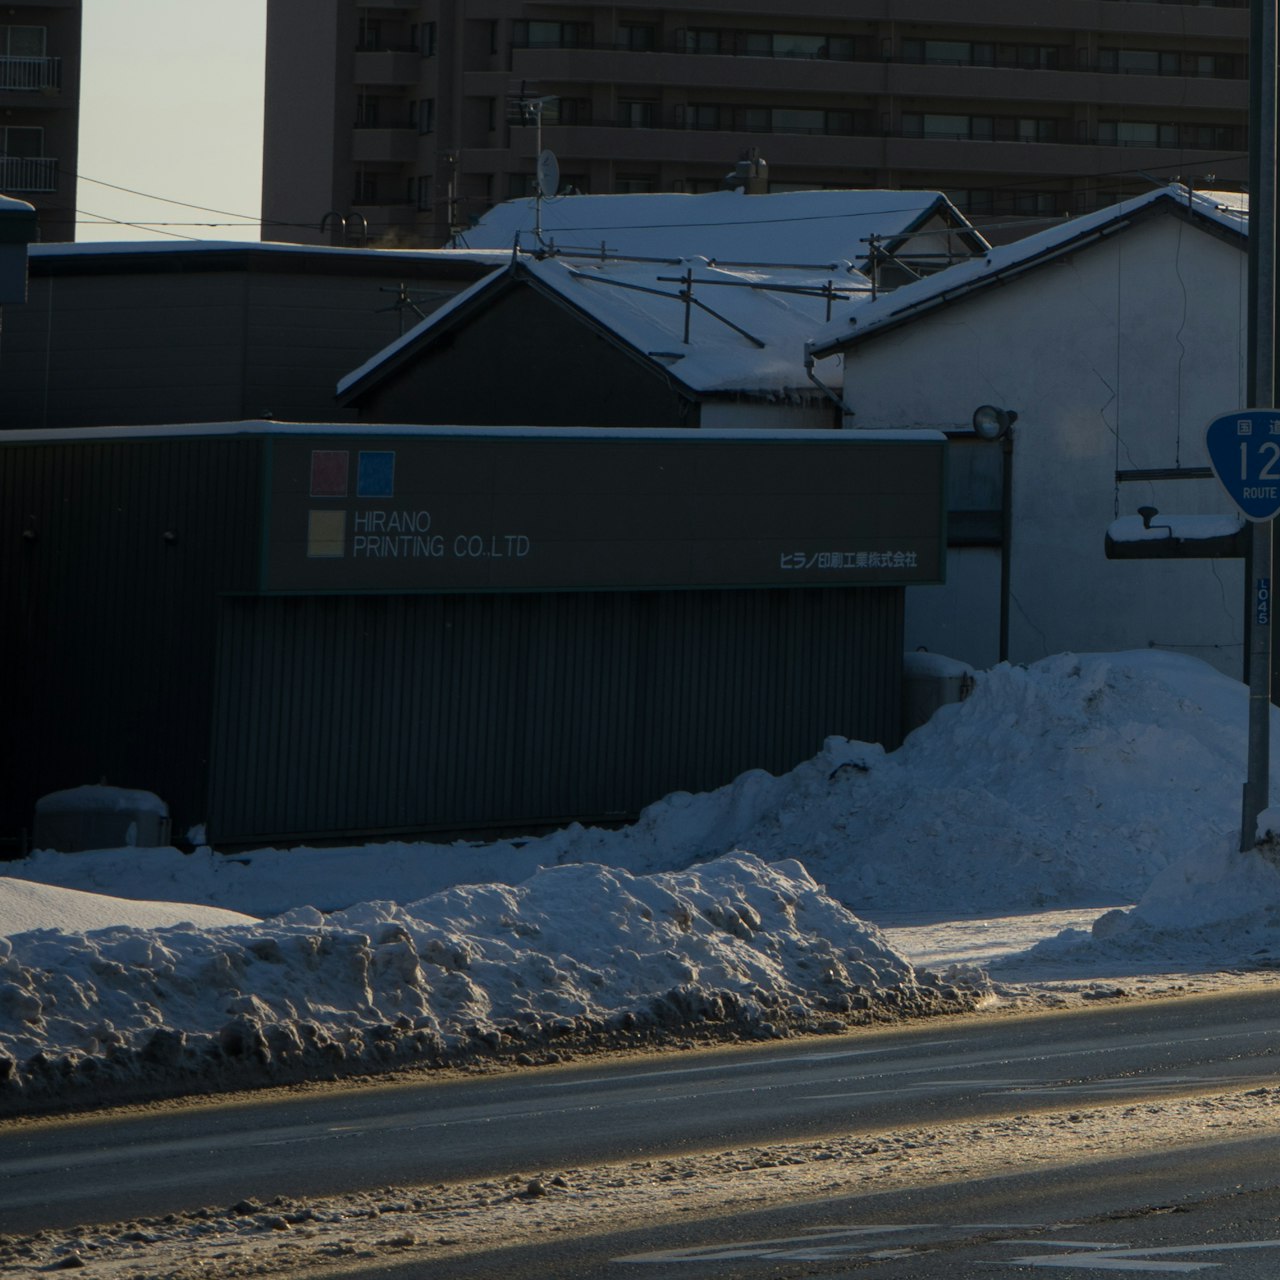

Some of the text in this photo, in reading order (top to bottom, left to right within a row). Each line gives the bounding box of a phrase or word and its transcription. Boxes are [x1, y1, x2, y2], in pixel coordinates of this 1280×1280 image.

[1240, 441, 1280, 480] 12
[1243, 486, 1278, 499] ROUTE
[354, 511, 432, 532] HIRANO
[354, 535, 444, 558] PRINTING
[780, 551, 918, 569] ヒラノ印刷工業株式会社
